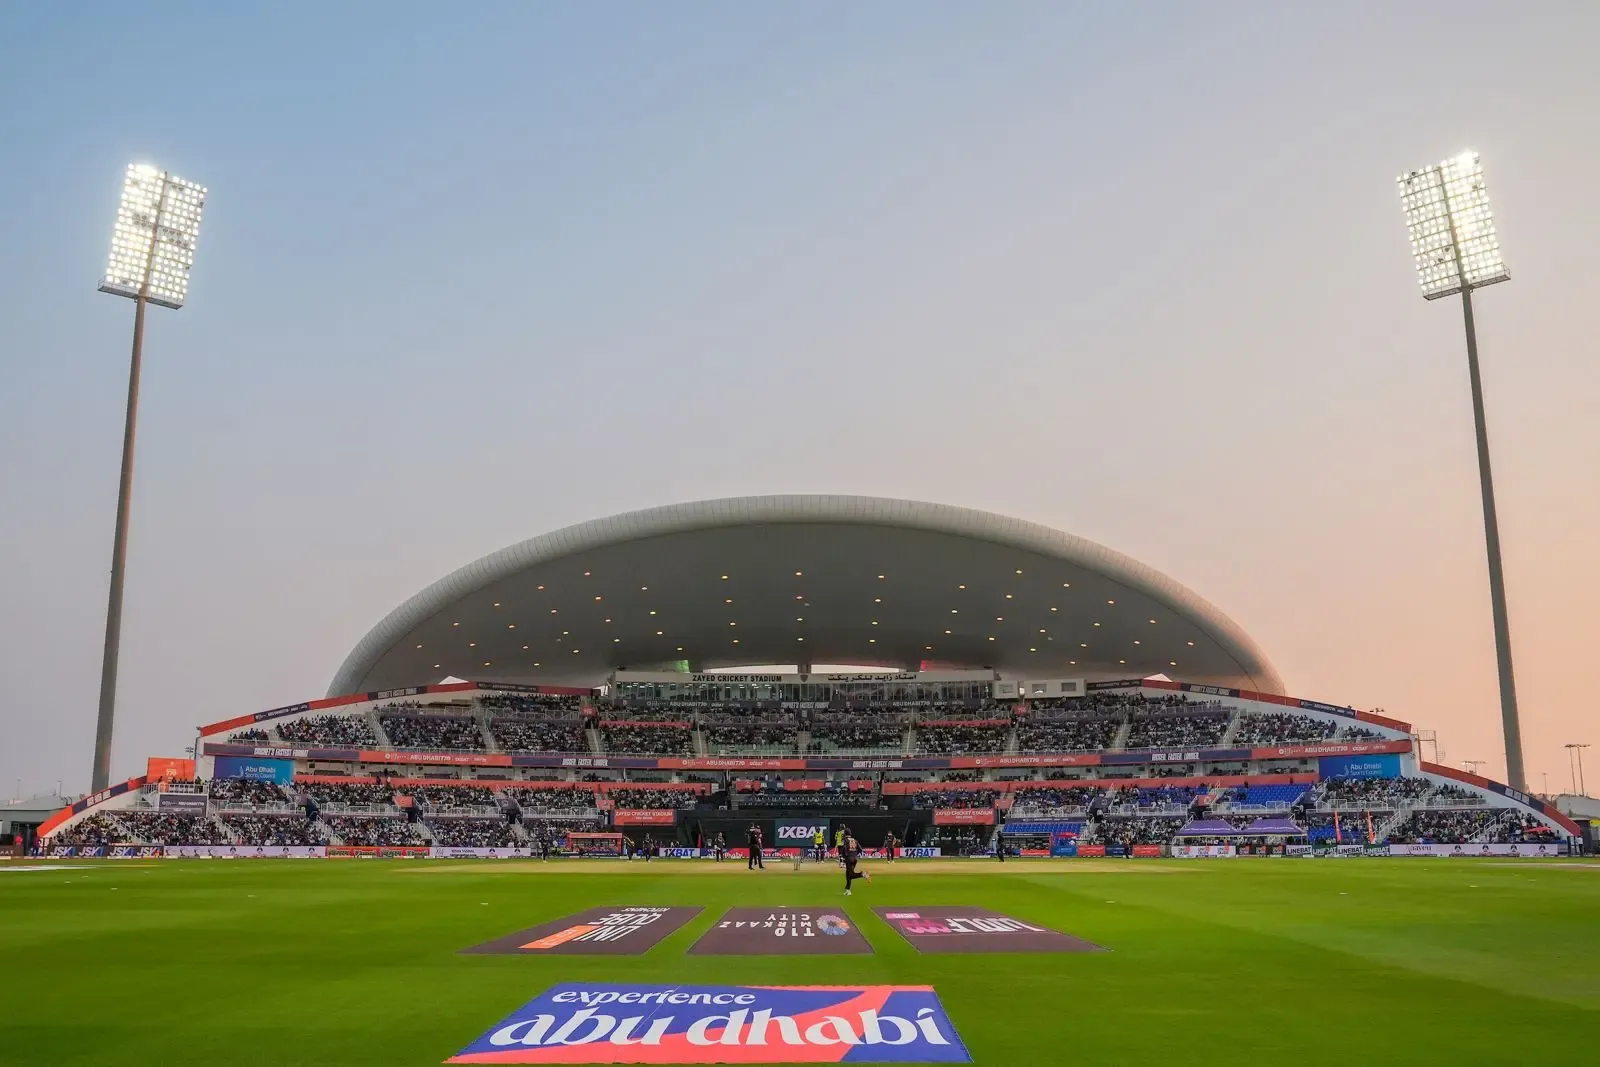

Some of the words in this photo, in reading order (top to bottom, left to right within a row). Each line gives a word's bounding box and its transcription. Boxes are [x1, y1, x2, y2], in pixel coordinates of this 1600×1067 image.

[905, 848, 935, 857] 1XBAT
[587, 913, 662, 925] QUBE
[571, 926, 641, 942] UNI
[775, 928, 815, 936] T10
[552, 988, 756, 1007] experience
[488, 1008, 672, 1045] abu
[686, 1007, 951, 1045] dhabi
